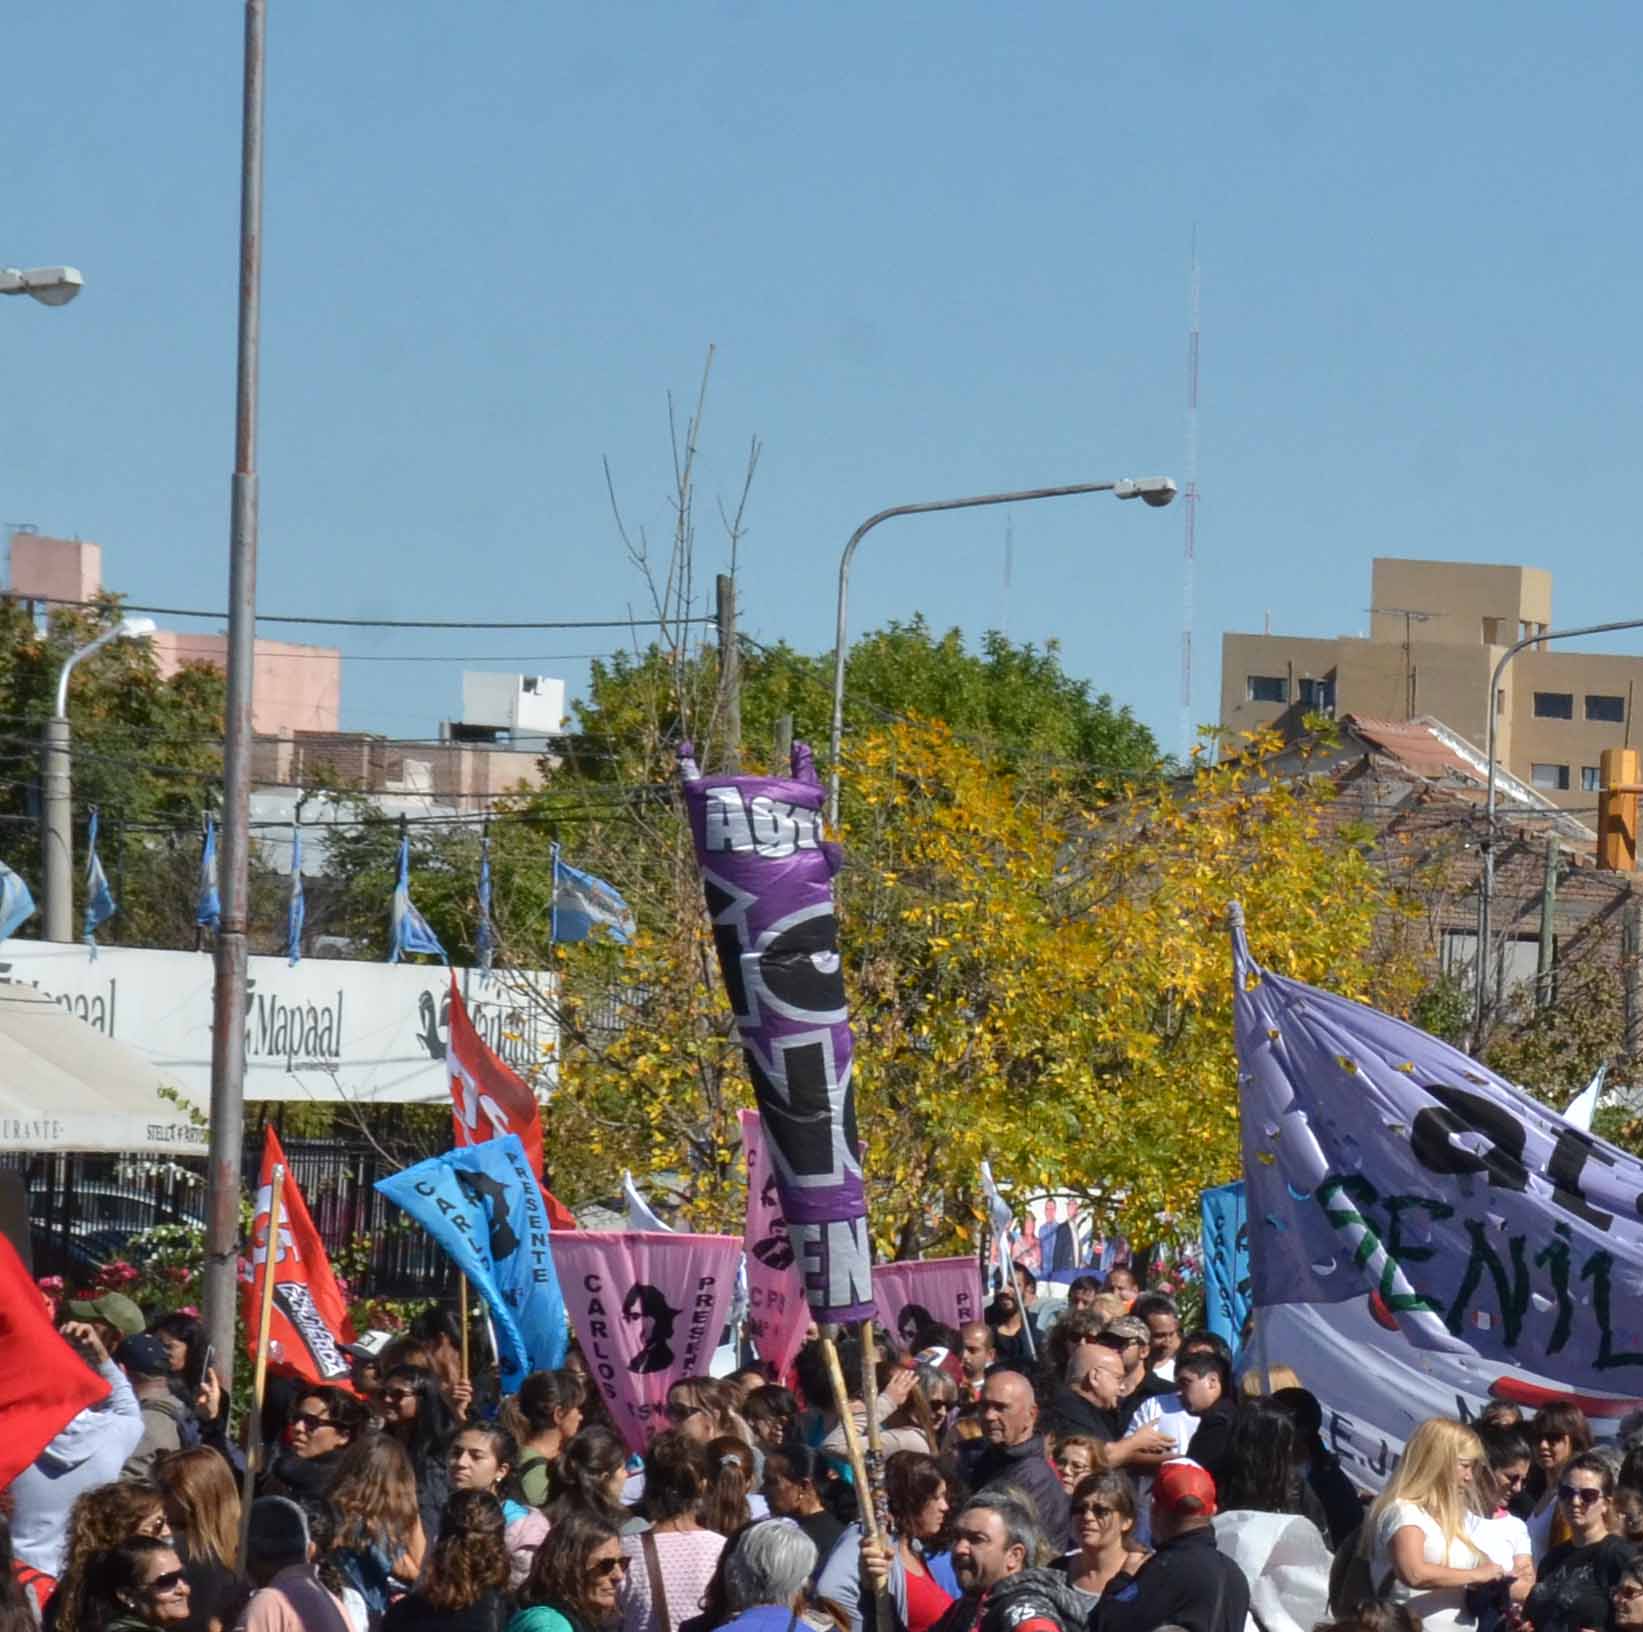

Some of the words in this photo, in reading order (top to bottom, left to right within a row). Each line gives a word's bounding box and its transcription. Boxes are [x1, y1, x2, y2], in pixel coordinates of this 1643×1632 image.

[254, 990, 343, 1072] Mapaal
[504, 1151, 549, 1283] PRESENTE
[583, 1274, 617, 1400] CARLOS
